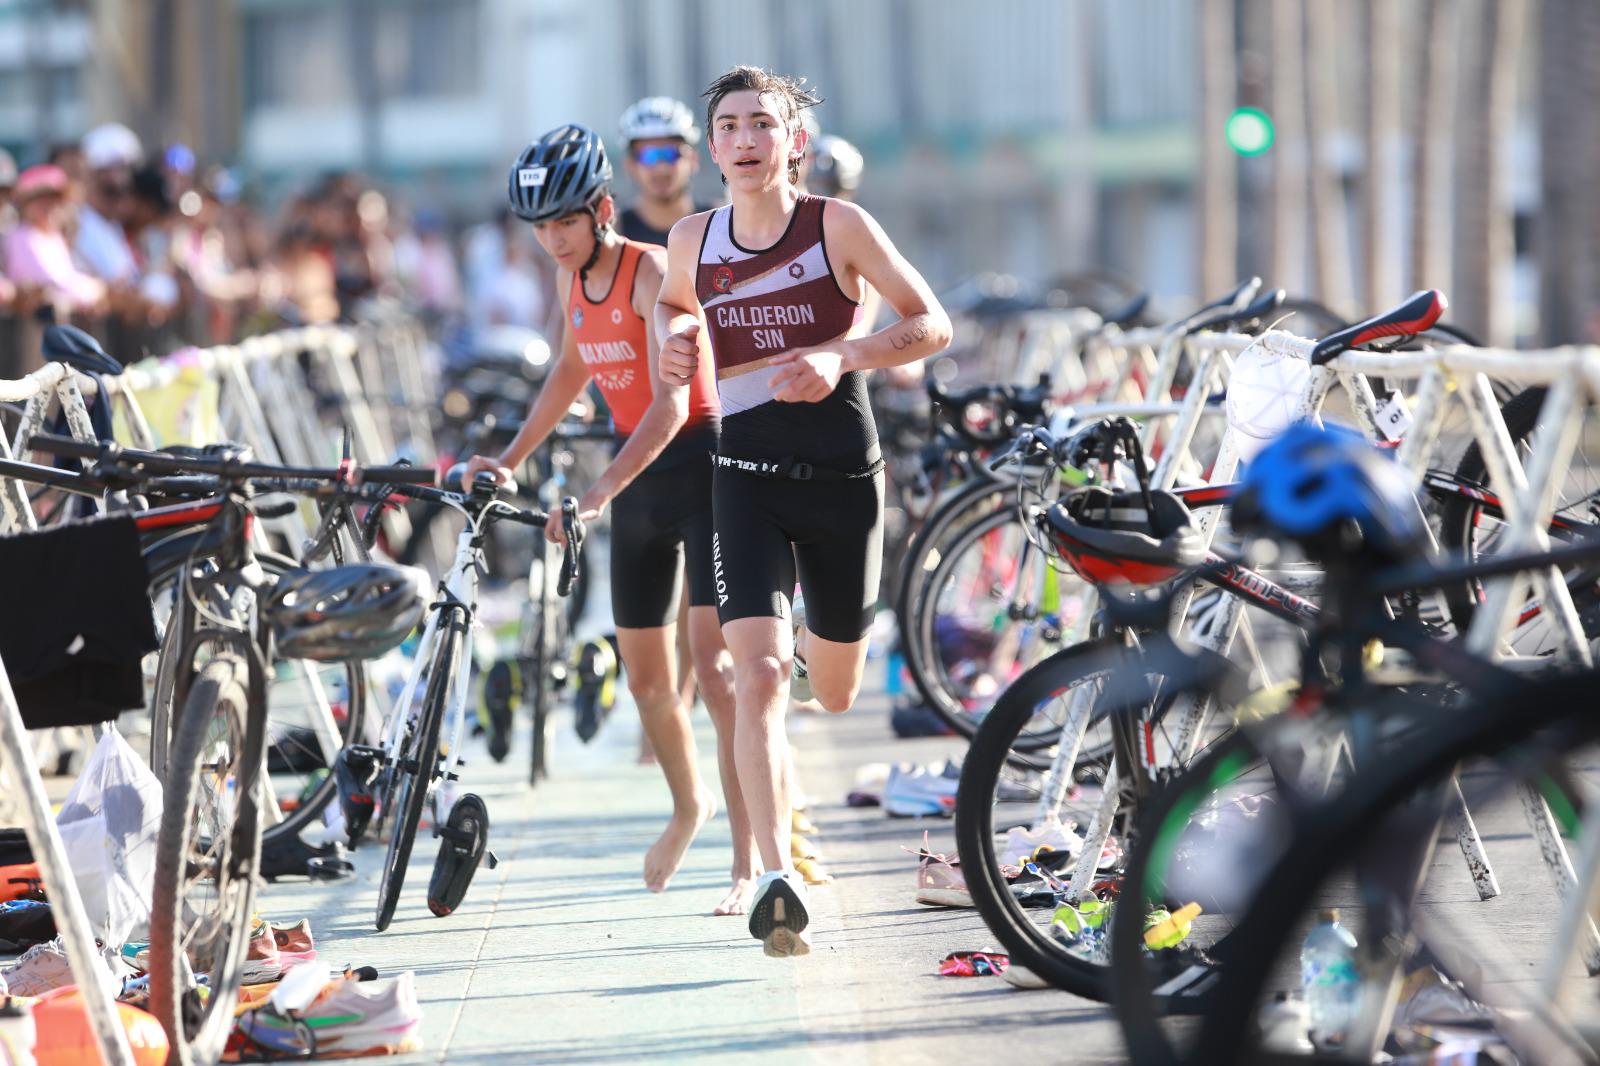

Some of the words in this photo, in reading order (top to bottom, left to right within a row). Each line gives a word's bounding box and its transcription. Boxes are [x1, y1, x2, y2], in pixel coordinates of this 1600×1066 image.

[717, 303, 815, 331] CALDERON
[752, 330, 786, 349] SIN
[713, 532, 728, 608] SINALOA
